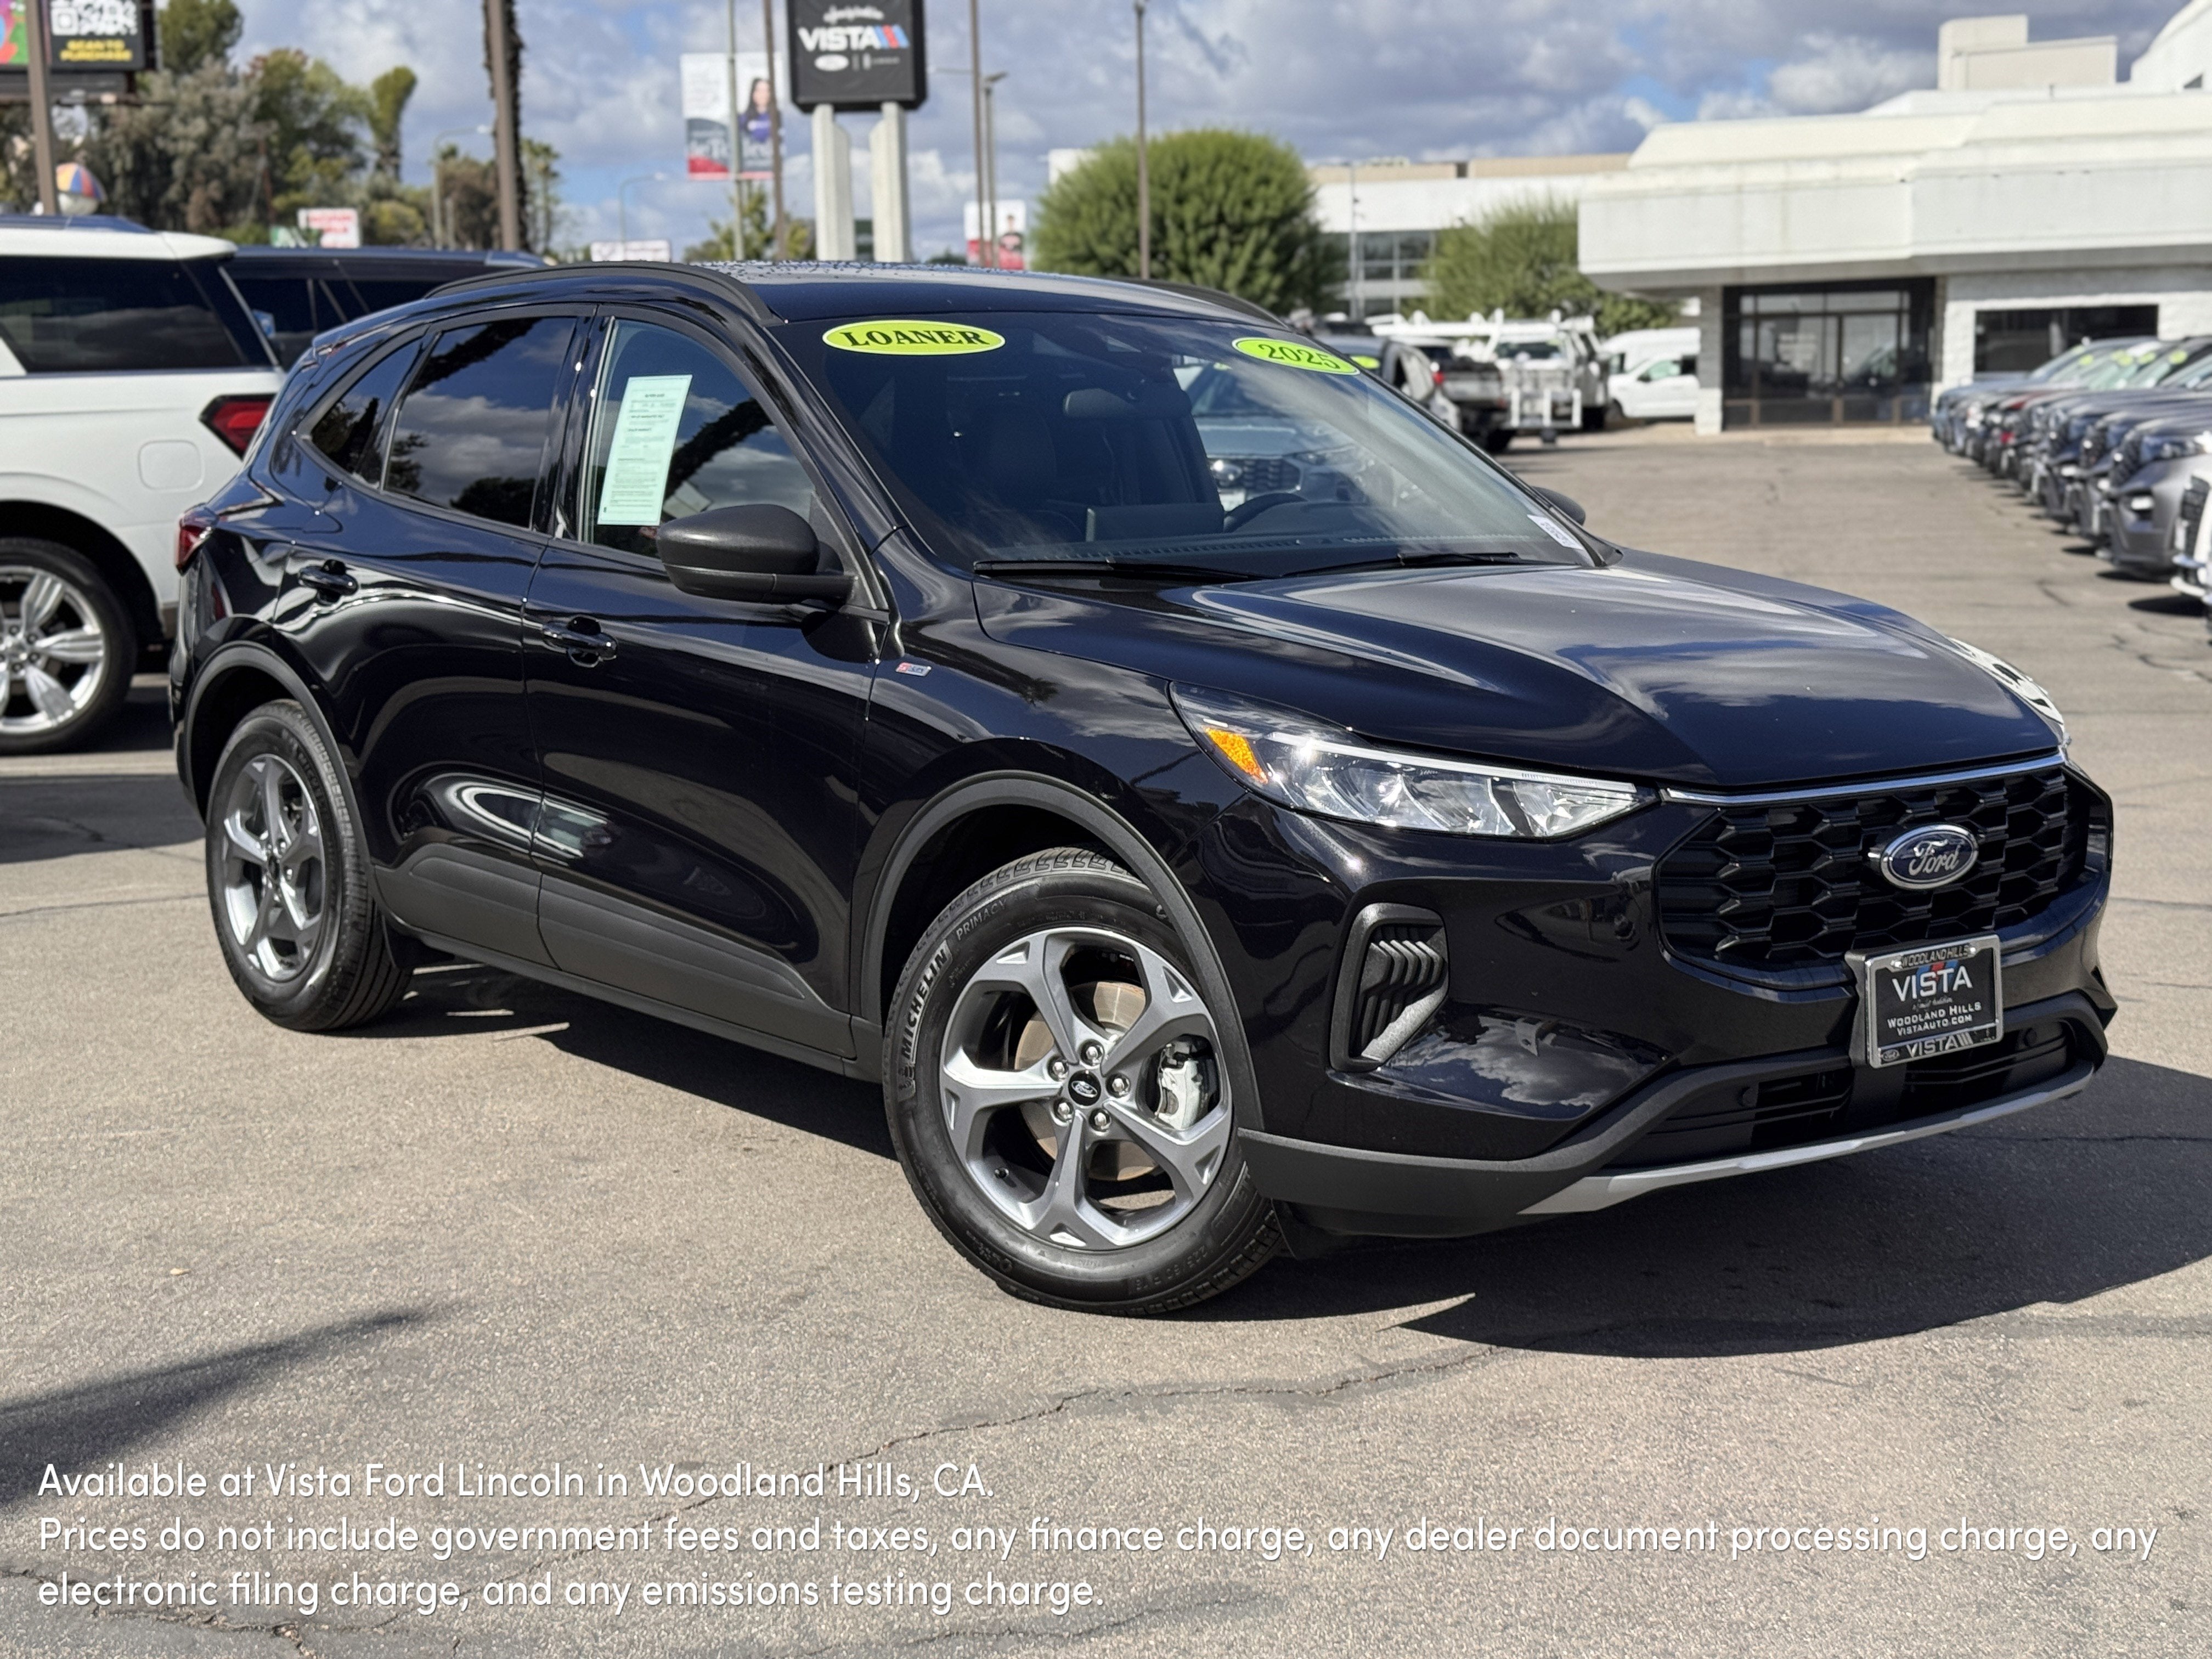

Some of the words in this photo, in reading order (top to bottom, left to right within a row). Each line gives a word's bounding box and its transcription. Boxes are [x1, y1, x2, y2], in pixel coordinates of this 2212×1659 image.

[798, 25, 882, 52] VISTA
[840, 330, 991, 347] LOANER
[1258, 343, 1340, 370] 2025
[1909, 838, 1962, 876] Ford
[956, 899, 1007, 941] PRIMACY
[1901, 948, 1947, 969] WOODLAND
[1892, 965, 1973, 1002] VISTA
[901, 949, 949, 1060] MICHELIN
[1887, 1008, 1946, 1029] WOODLAND
[1949, 1001, 1982, 1016] HILLS
[1897, 1014, 1973, 1037] VISTAAUTO.COM
[1906, 1032, 1959, 1058] VISTA
